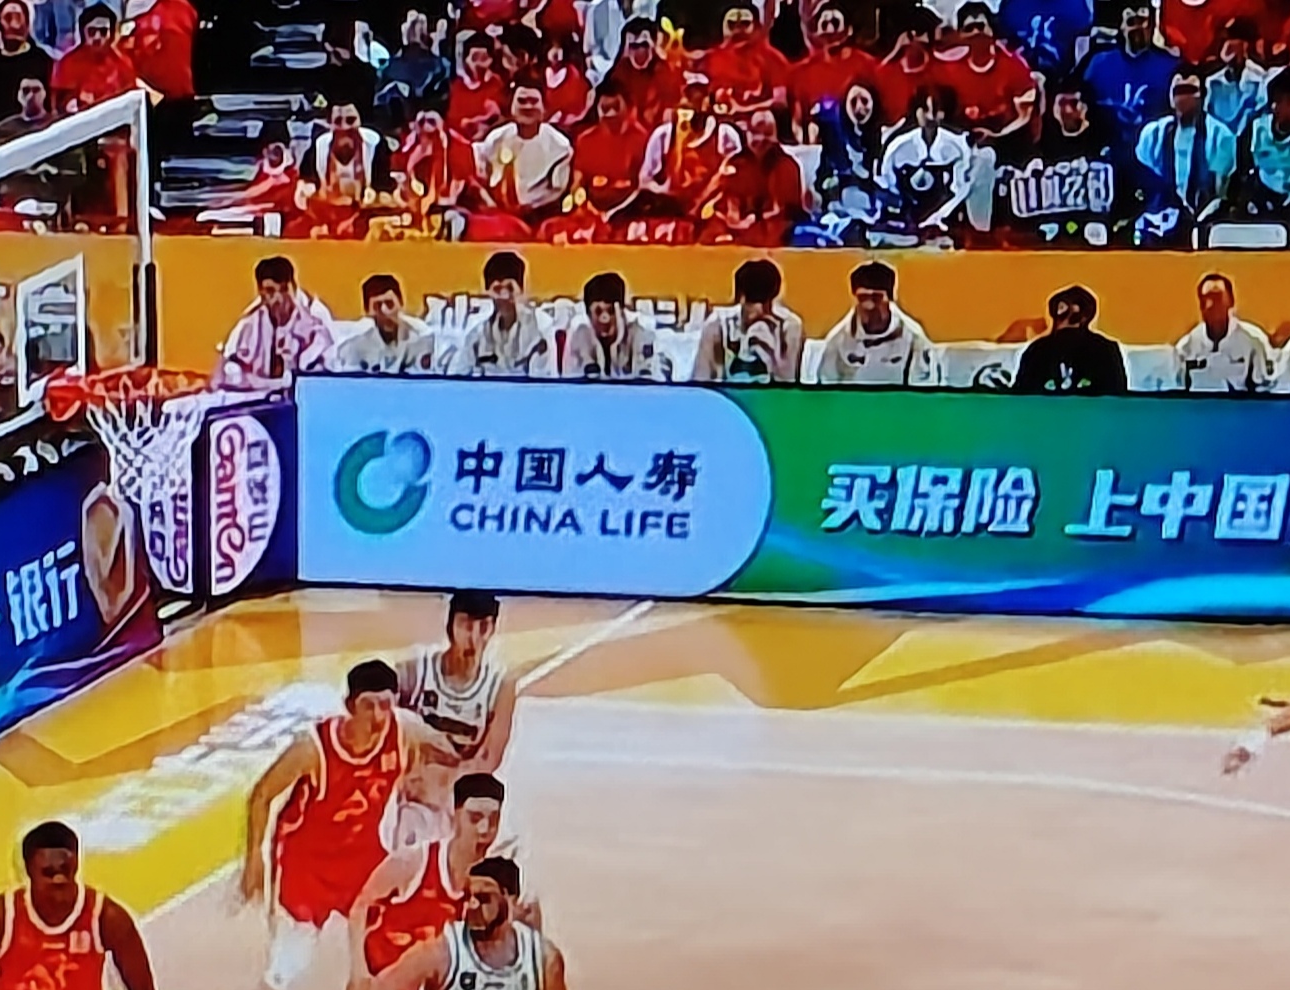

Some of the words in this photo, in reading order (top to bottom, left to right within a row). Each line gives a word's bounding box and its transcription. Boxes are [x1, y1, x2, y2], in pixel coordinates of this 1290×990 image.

[450, 504, 582, 535] CHINA
[600, 508, 691, 539] LIFE
[821, 464, 1037, 534] 买保险
